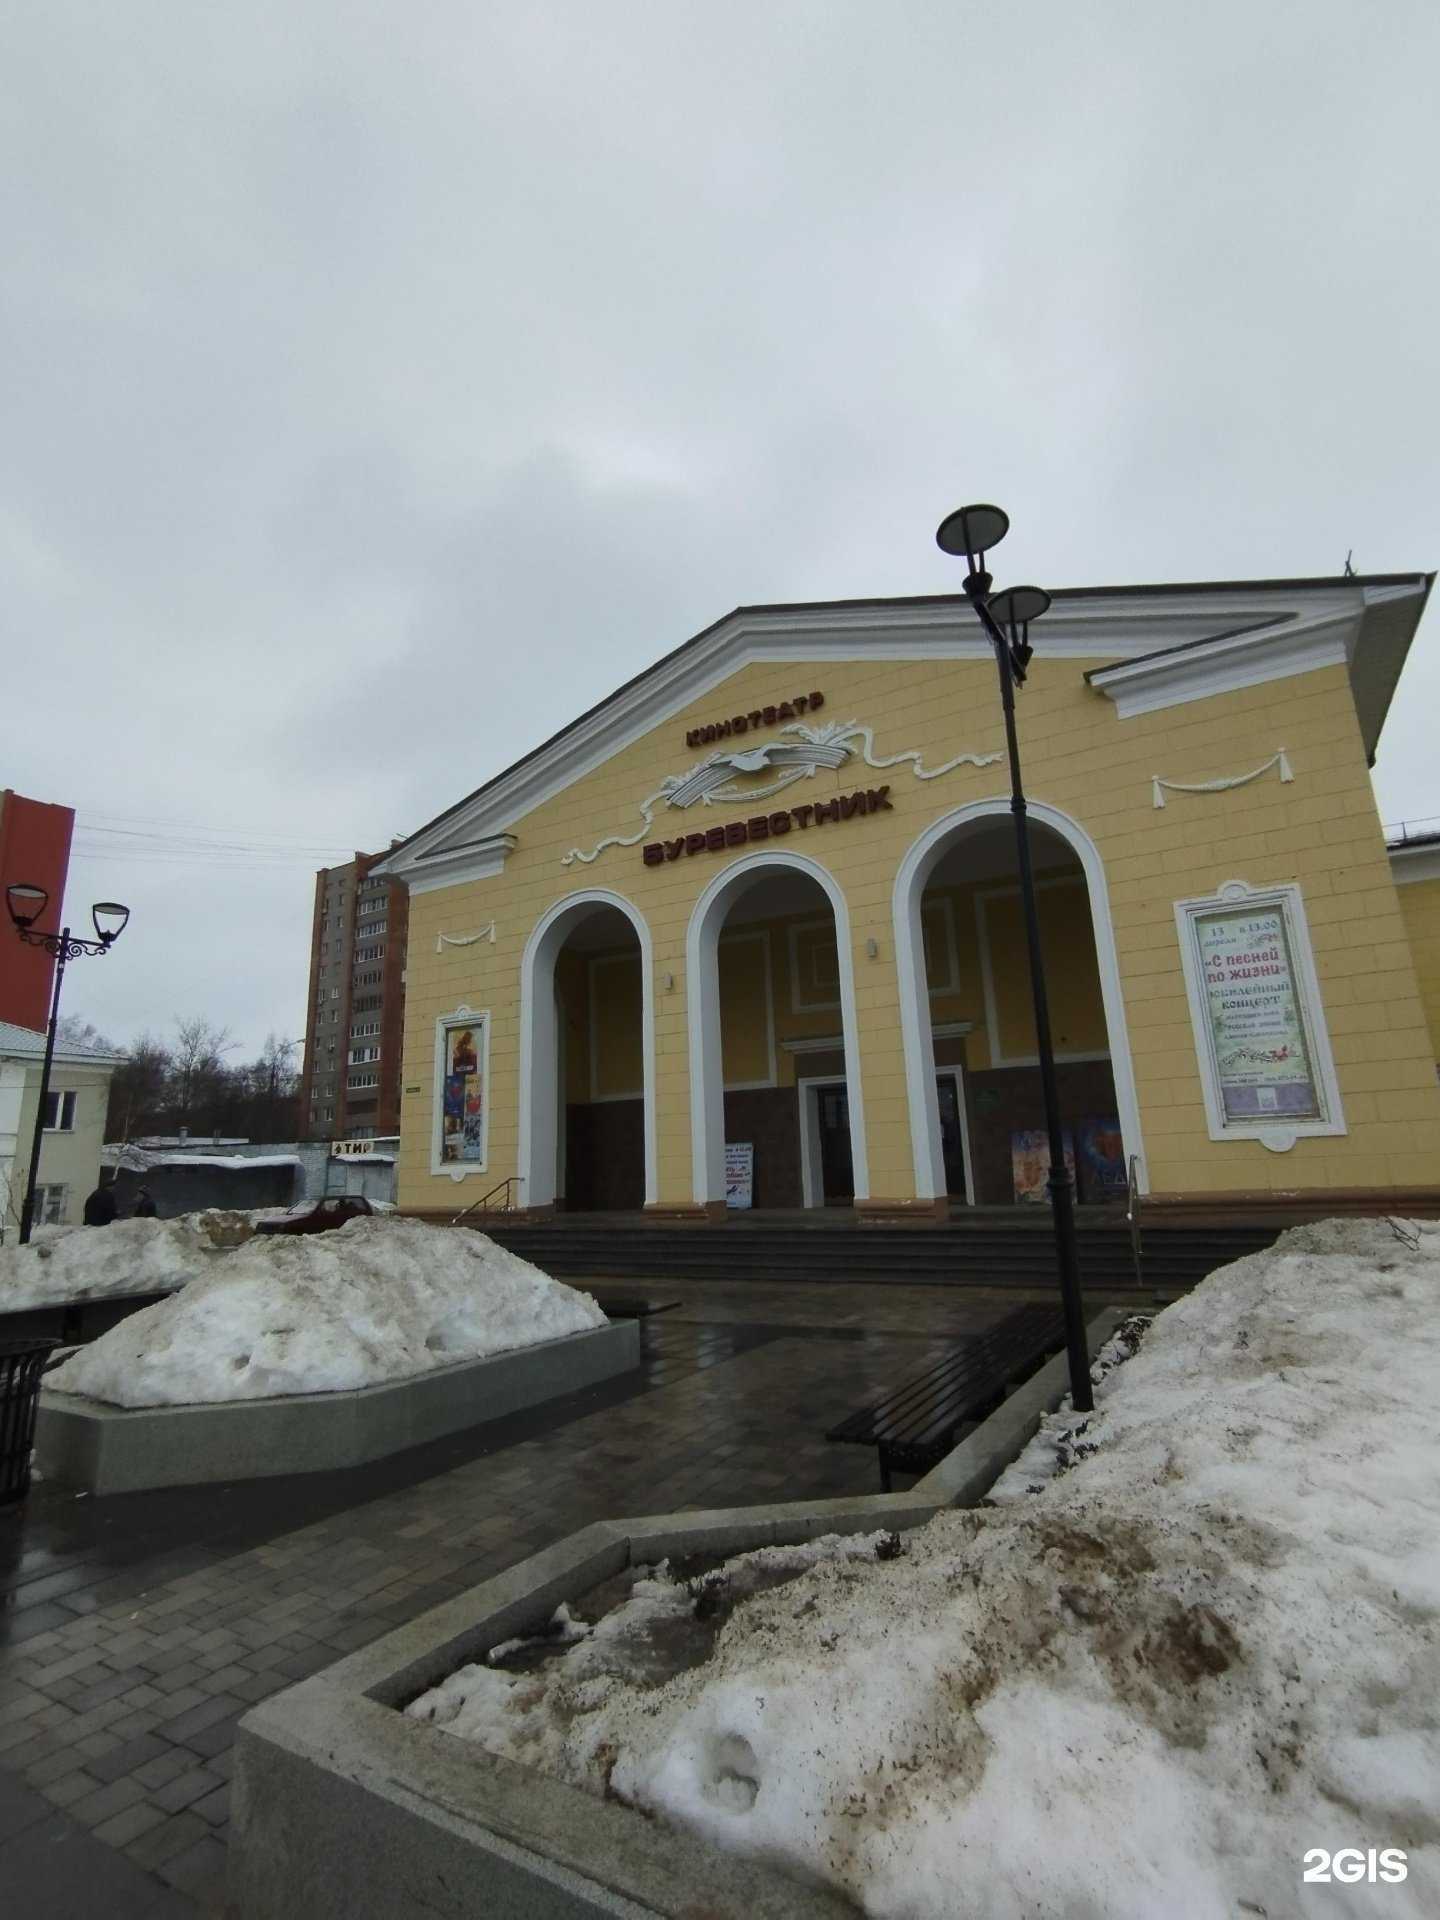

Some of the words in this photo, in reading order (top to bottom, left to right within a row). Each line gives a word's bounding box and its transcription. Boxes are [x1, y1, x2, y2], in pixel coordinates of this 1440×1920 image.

[686, 691, 825, 748] КИНОТЕАТР
[643, 785, 894, 866] БУРЕВЕСТНИК
[1226, 947, 1279, 965] песней
[1208, 972, 1225, 983] по
